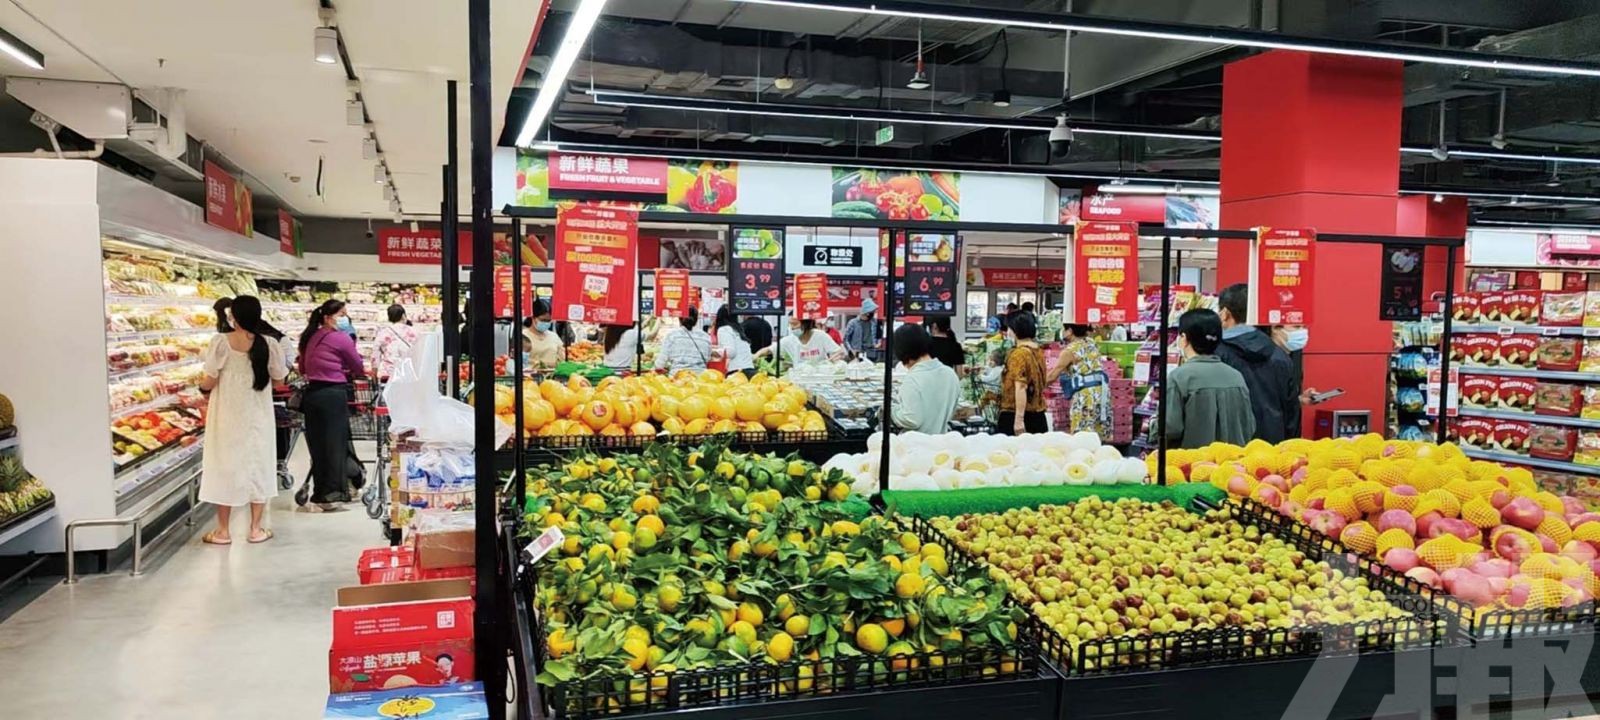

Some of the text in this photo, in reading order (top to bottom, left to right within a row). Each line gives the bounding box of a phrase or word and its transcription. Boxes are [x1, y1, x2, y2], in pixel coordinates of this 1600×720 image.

[559, 155, 629, 174] 新鲜蔬果
[1090, 193, 1115, 206] 水产
[1089, 206, 1122, 215] SEAFOOD
[387, 236, 442, 250] 新鲜蔬菜
[1467, 337, 1487, 346] ORION
[1487, 338, 1498, 347] PIE
[1501, 338, 1536, 347] ORION PIE
[1464, 379, 1496, 389] ORION PIE
[1500, 381, 1535, 391] ORION PIE
[1462, 420, 1493, 431] ORION PIE
[1495, 423, 1529, 434] ORION PIE
[363, 651, 421, 669] 盐源苹果
